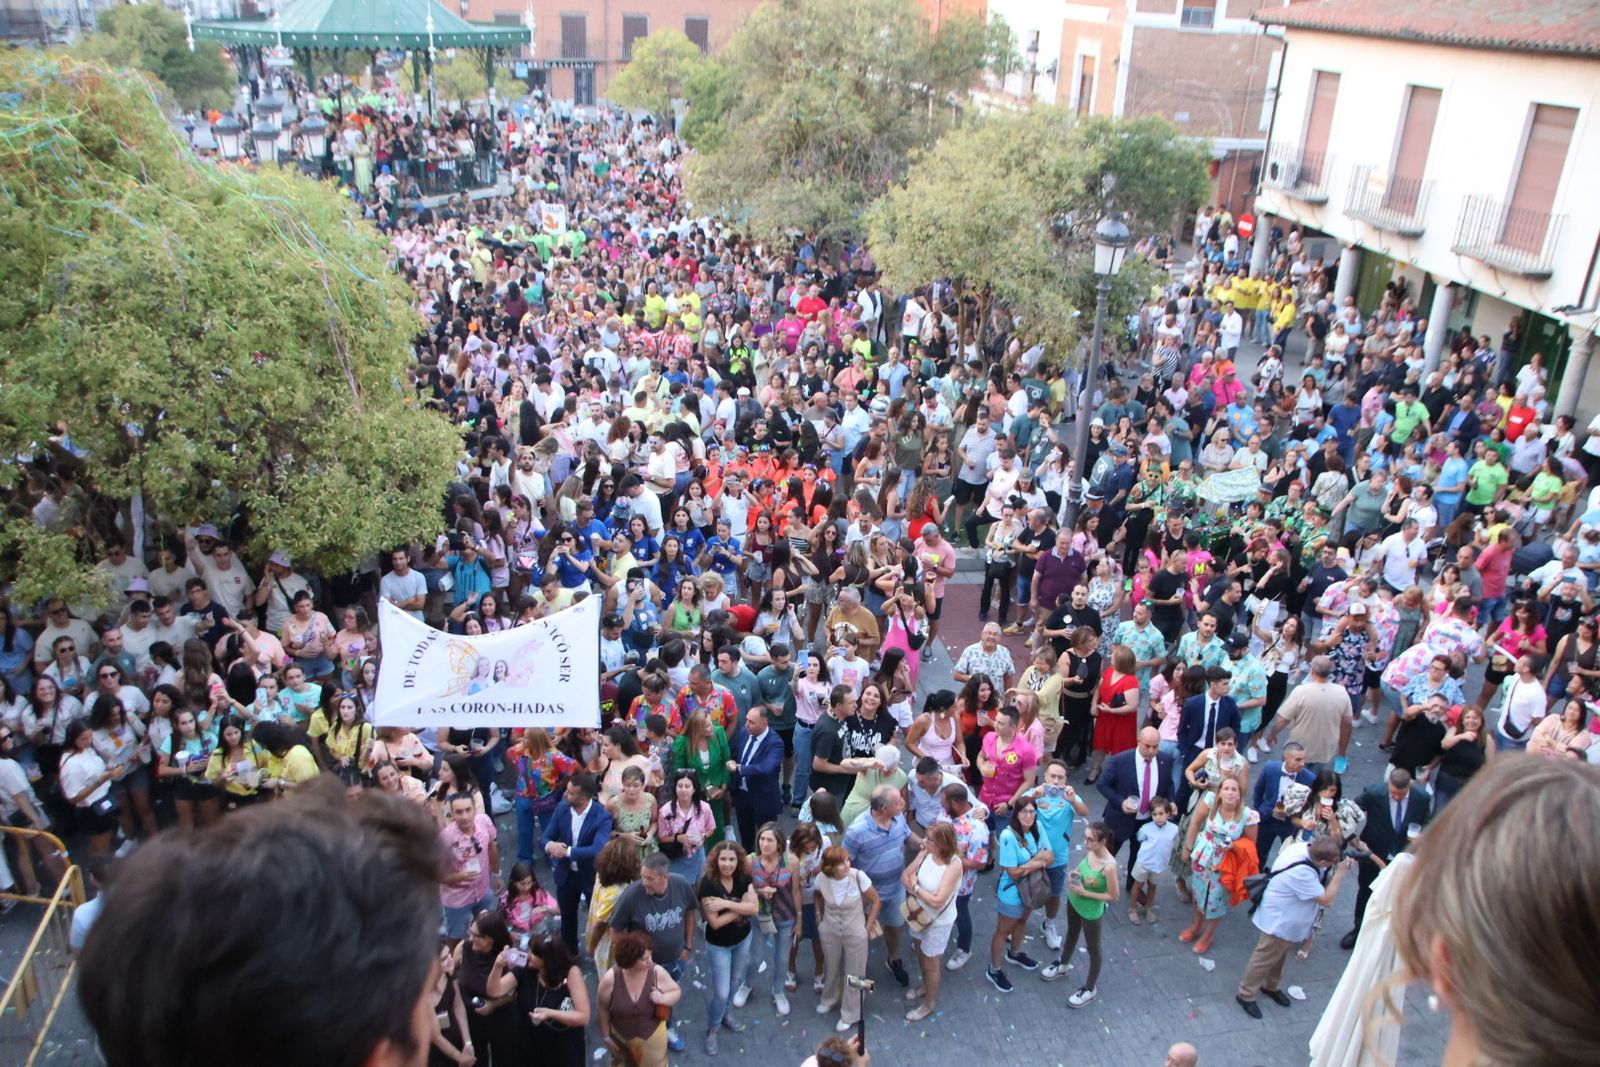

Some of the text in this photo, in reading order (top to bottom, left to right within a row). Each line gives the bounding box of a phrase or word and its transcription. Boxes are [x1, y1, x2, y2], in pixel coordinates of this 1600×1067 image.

[403, 630, 440, 688] DE TODAS
[559, 656, 571, 683] SER
[450, 703, 564, 714] CORON-HADAS
